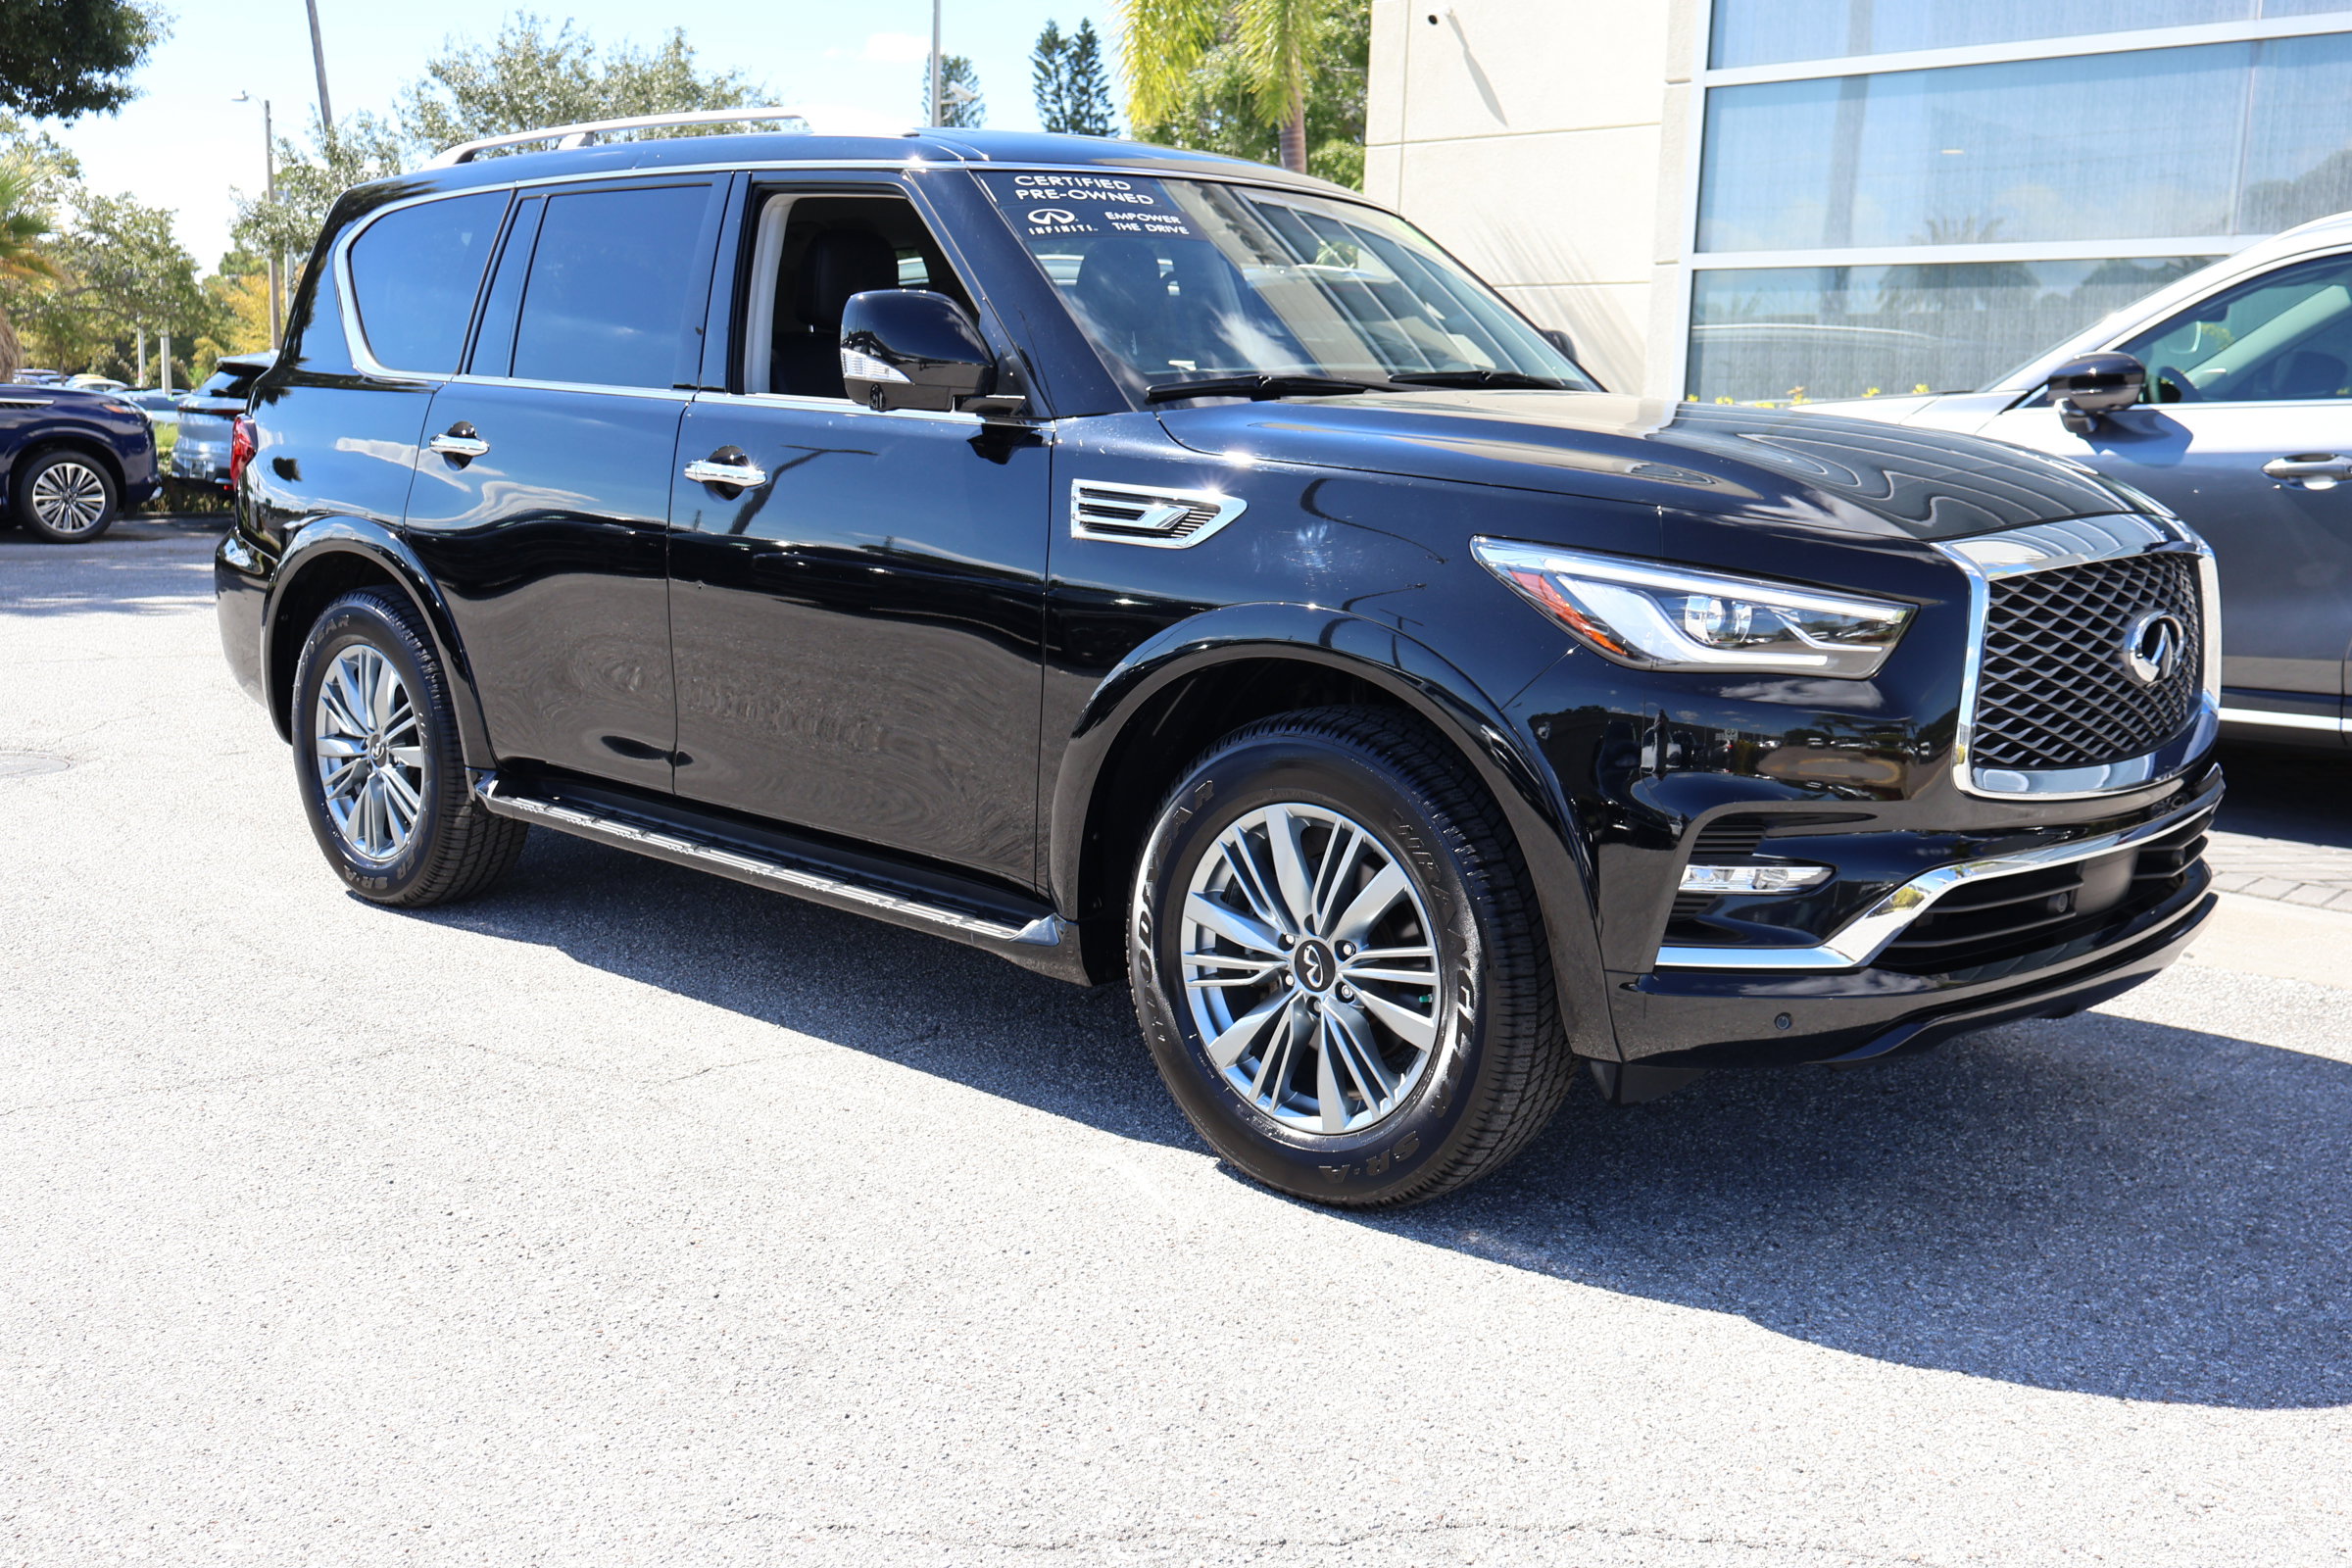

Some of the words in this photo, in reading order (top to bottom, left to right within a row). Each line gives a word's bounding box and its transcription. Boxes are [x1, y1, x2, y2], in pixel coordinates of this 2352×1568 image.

[1014, 175, 1132, 191] CERTIFIED
[1015, 189, 1154, 205] PRE-OWNED
[1104, 212, 1182, 224] EMPOWER
[1028, 224, 1094, 235] INFINITI
[1111, 222, 1142, 232] THE
[1146, 222, 1190, 235] DRIVE
[1392, 807, 1476, 1119] WRANGLER
